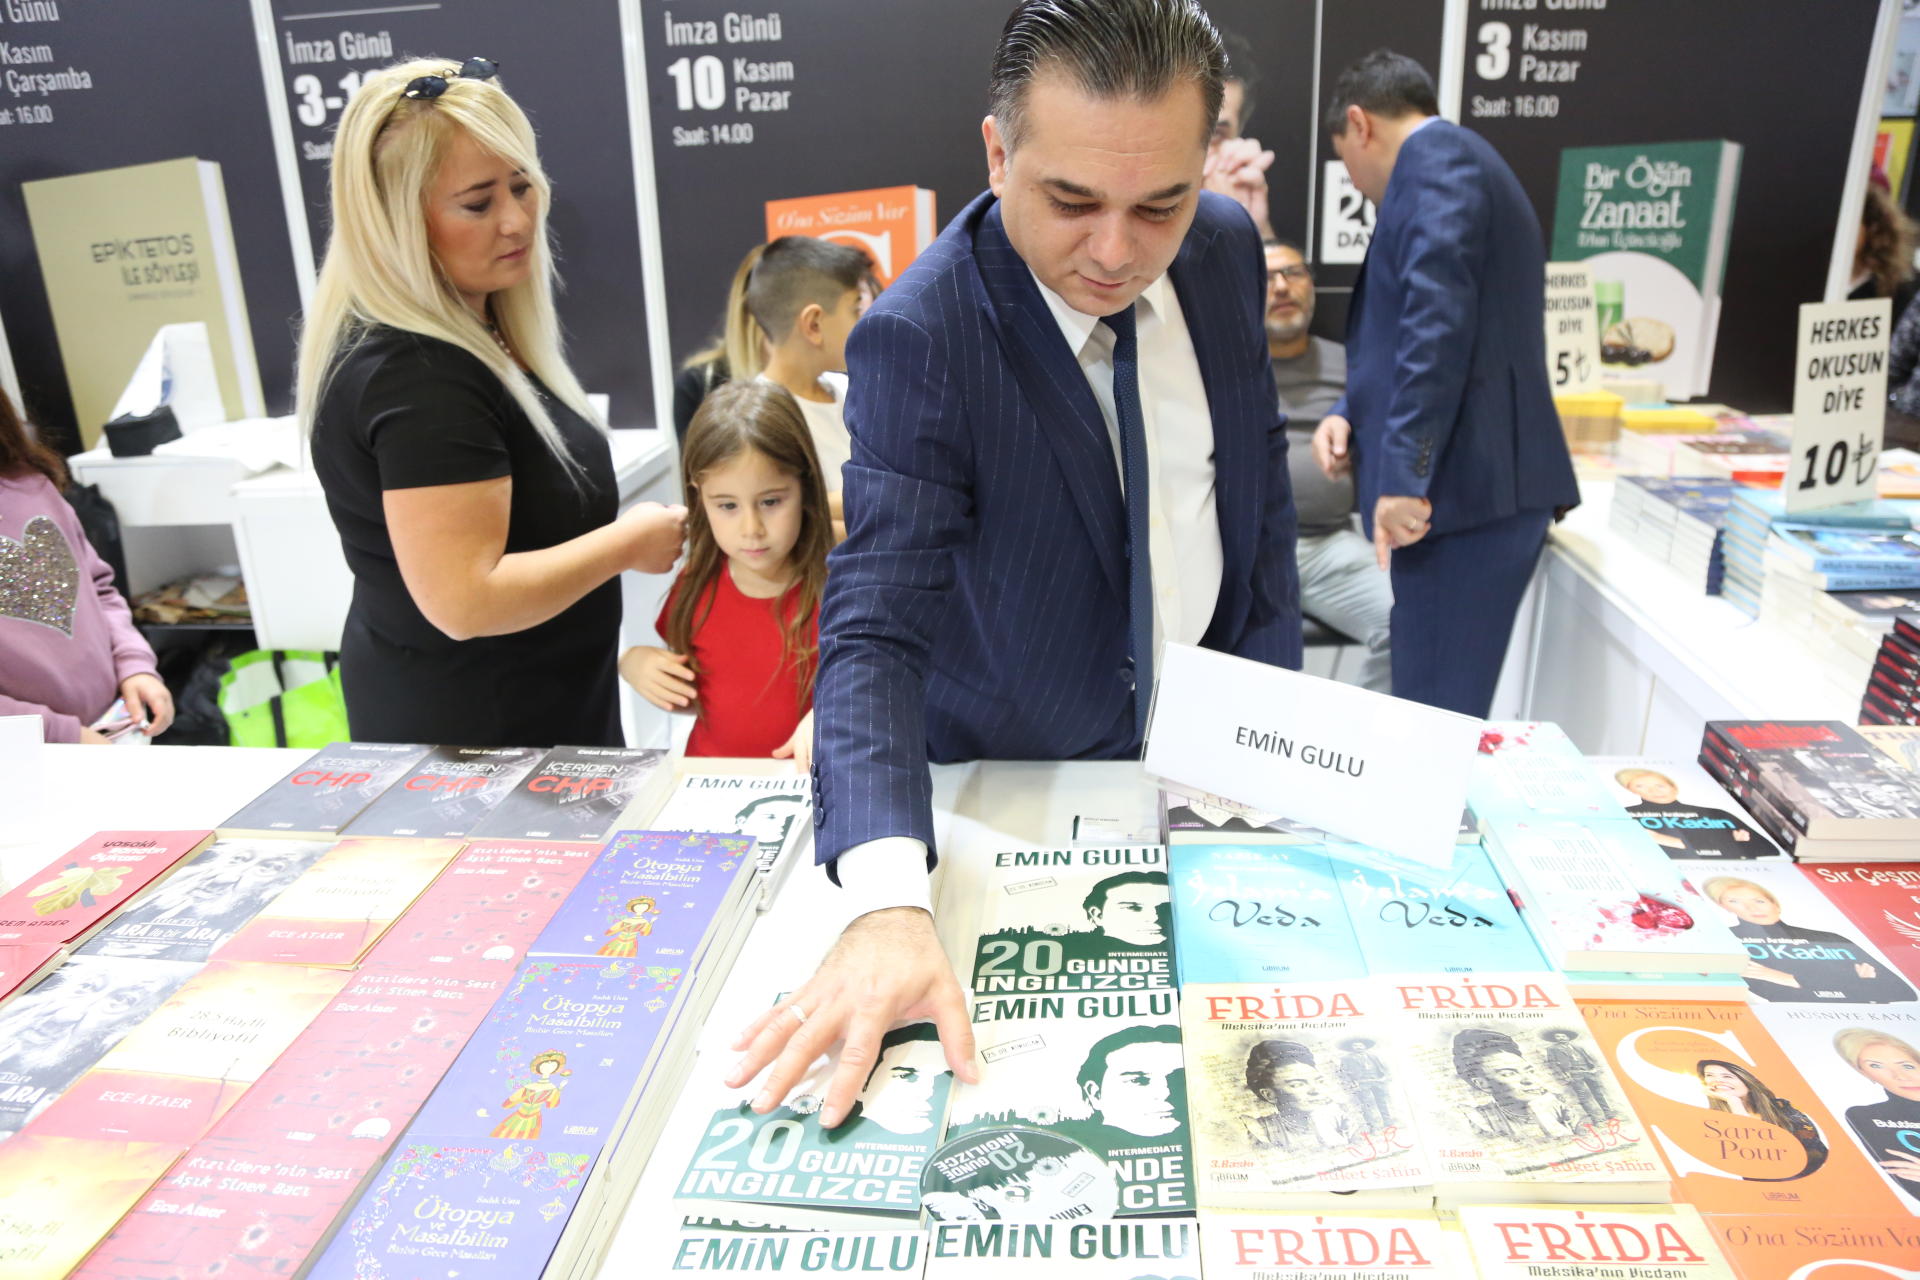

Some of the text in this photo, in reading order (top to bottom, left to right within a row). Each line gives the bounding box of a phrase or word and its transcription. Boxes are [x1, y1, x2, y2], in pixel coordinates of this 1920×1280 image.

[664, 11, 782, 46] İmza Günü
[0, 41, 54, 64] Kasım
[285, 30, 393, 64] İmza Günü
[1475, 21, 1588, 80] 3 Kasım
[1519, 54, 1581, 82] Pazar
[5, 66, 93, 97] Çarşamba
[667, 55, 794, 111] 10 Kasım
[735, 86, 791, 112] Pazar
[1471, 94, 1560, 118] Saat: 16.00
[15, 104, 54, 124] 16.00
[672, 123, 754, 147] Saat: 14.00
[1584, 155, 1692, 198] Bir Öğün
[1580, 190, 1687, 230] Zanaat
[90, 233, 194, 264] EPİKTETOS
[1545, 272, 1587, 289] HERKES
[1545, 296, 1592, 312] OKUSUN
[1558, 317, 1583, 335] DİYE
[1810, 316, 1881, 345] HERKES
[1808, 351, 1884, 381] OKUSUN
[1823, 385, 1864, 414] DİYE
[1300, 744, 1365, 778] GULU
[290, 770, 373, 787] CHP
[404, 775, 490, 792] CHP
[527, 776, 613, 795] CHP
[1640, 816, 1736, 830] O Kadın
[633, 857, 703, 873] Ütopya
[1082, 848, 1161, 866] GULU
[620, 870, 701, 883] Masalbilim
[1817, 868, 1920, 886] Sır Çeşm
[1208, 900, 1322, 928] Veda
[1379, 900, 1496, 929] Veda
[110, 923, 222, 941] ARA ARA
[267, 930, 345, 940] ECE ATAER
[978, 939, 1063, 977] 20
[1766, 944, 1857, 960] Kadın
[1066, 958, 1169, 974] GUNDE
[388, 986, 465, 999] Sinem Bacı
[464, 979, 498, 990] Sesi
[1396, 977, 1560, 1010] FRİDA
[542, 995, 625, 1017] Ütopya
[1077, 993, 1172, 1019] GULU
[1206, 988, 1364, 1021] FRİDA
[1418, 1011, 1544, 1020] Meksika'nın Vicdanı
[1705, 1007, 1745, 1021] Var
[526, 1013, 622, 1029] Masalbilim
[1221, 1021, 1348, 1031] Meksika'nın Vicdanı
[1867, 1012, 1917, 1023] KAYA
[98, 1090, 193, 1109] ECE ATAER
[1704, 1120, 1776, 1141] Sara
[693, 1118, 805, 1173] 20
[854, 1142, 927, 1153] INTERMEDIATE
[990, 1142, 1037, 1171] 20
[1108, 1144, 1183, 1157] INTERMEDIATE
[1719, 1140, 1788, 1162] Pour
[315, 1166, 354, 1180] Sesi
[797, 1149, 926, 1178] GUNDE
[1108, 1156, 1185, 1182] NDE
[1603, 1159, 1656, 1175] Şahin
[218, 1177, 267, 1194] Sinem
[271, 1182, 311, 1197] Bacı
[147, 1199, 179, 1214] Ece
[413, 1195, 516, 1229] Ütopya
[390, 1223, 510, 1249] Masalbilim
[429, 1220, 447, 1232] ve
[1494, 1210, 1706, 1262] FRİDA
[1726, 1226, 1920, 1248] O'na Sözüm Va
[1069, 1223, 1189, 1260] GULU
[1230, 1216, 1432, 1266] FRİDA
[420, 1246, 449, 1259] Gece
[800, 1235, 919, 1271] GULU
[1528, 1265, 1687, 1279] Meksika'nın Vicdanı
